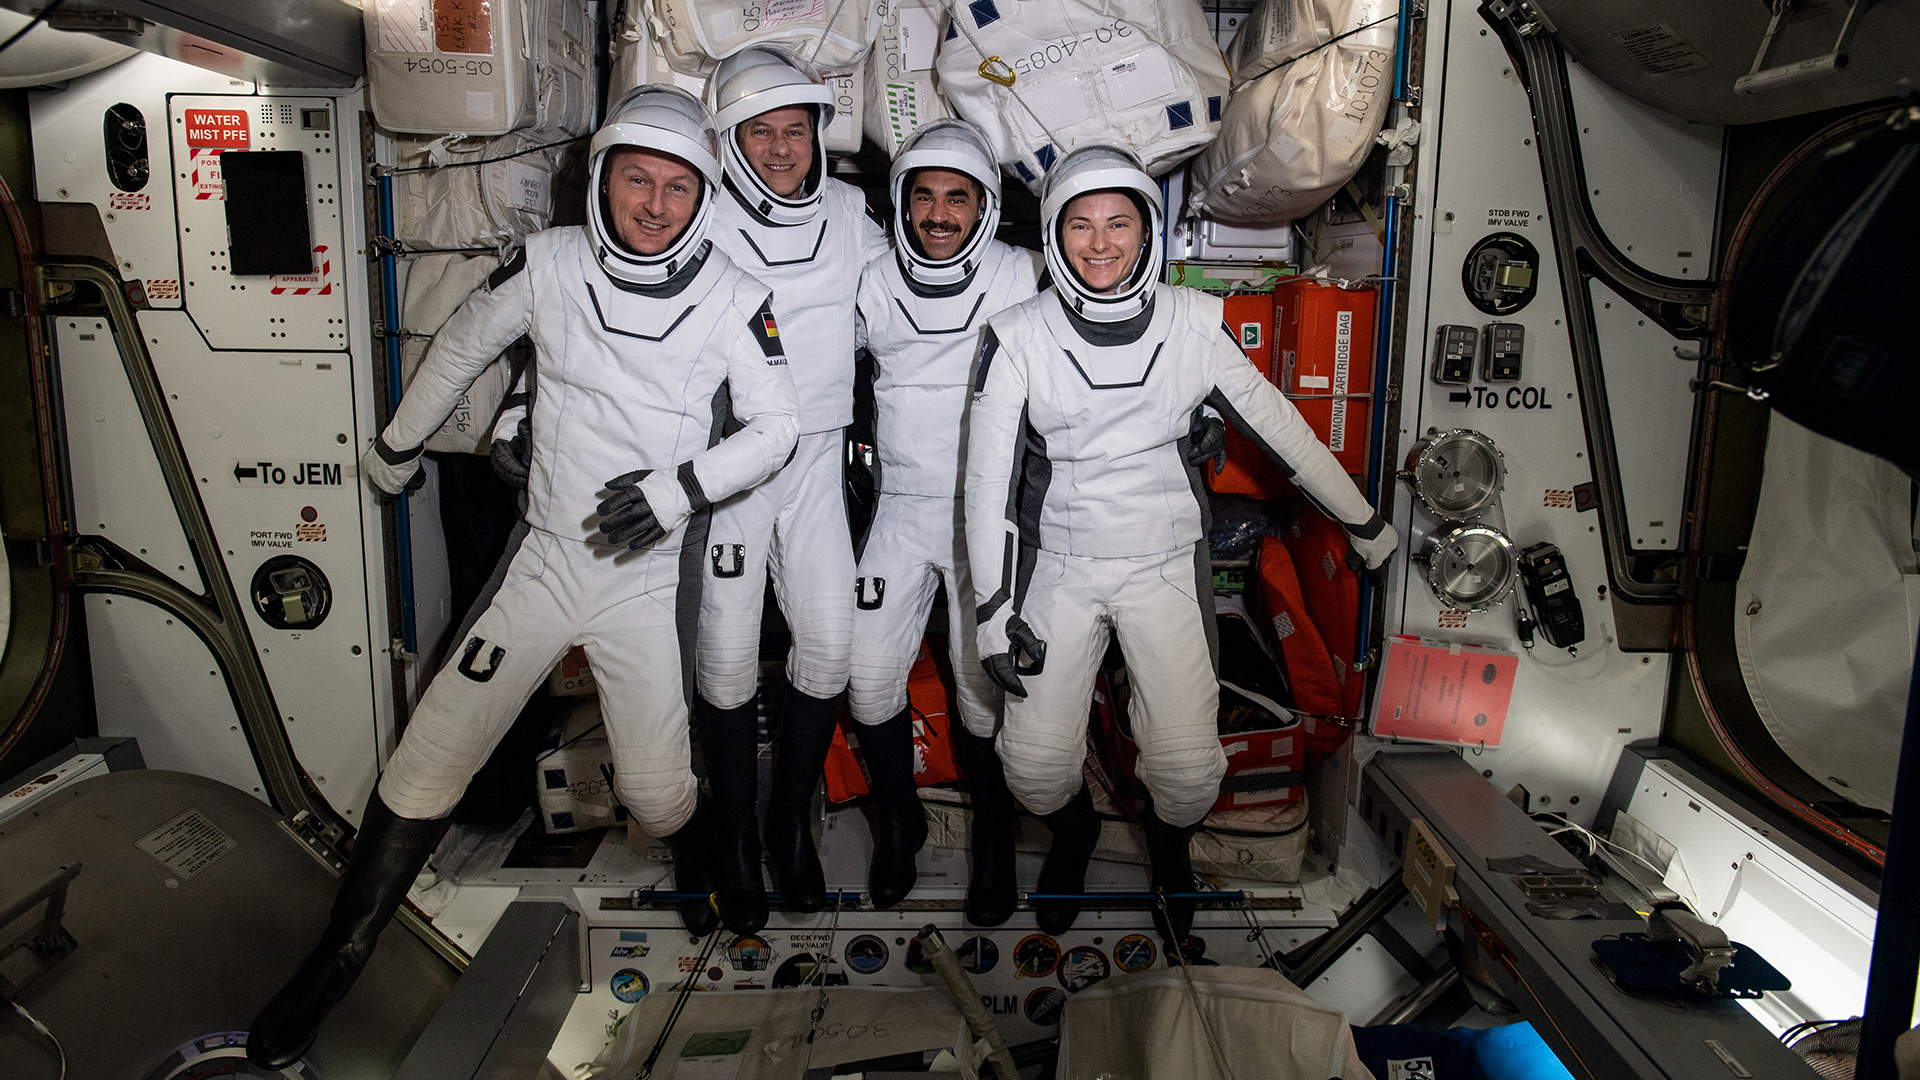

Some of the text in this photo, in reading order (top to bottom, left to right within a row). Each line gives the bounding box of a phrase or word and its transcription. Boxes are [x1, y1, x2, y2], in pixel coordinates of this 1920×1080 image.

[437, 14, 449, 37] ISS
[452, 18, 466, 49] LEAK
[1014, 18, 1132, 75] 3.0-4085
[404, 58, 493, 76] 0.5-5054
[1345, 50, 1388, 124] 1.0-1073
[193, 114, 241, 126] WATER
[189, 129, 247, 141] MIST PFE
[1488, 209, 1530, 218] STDB FWD
[1488, 218, 1529, 227] IMV VALVE
[1331, 314, 1350, 449] AMMONIA CARTRIDGE BAG
[1473, 387, 1553, 410] To COL
[257, 462, 342, 486] To JEM
